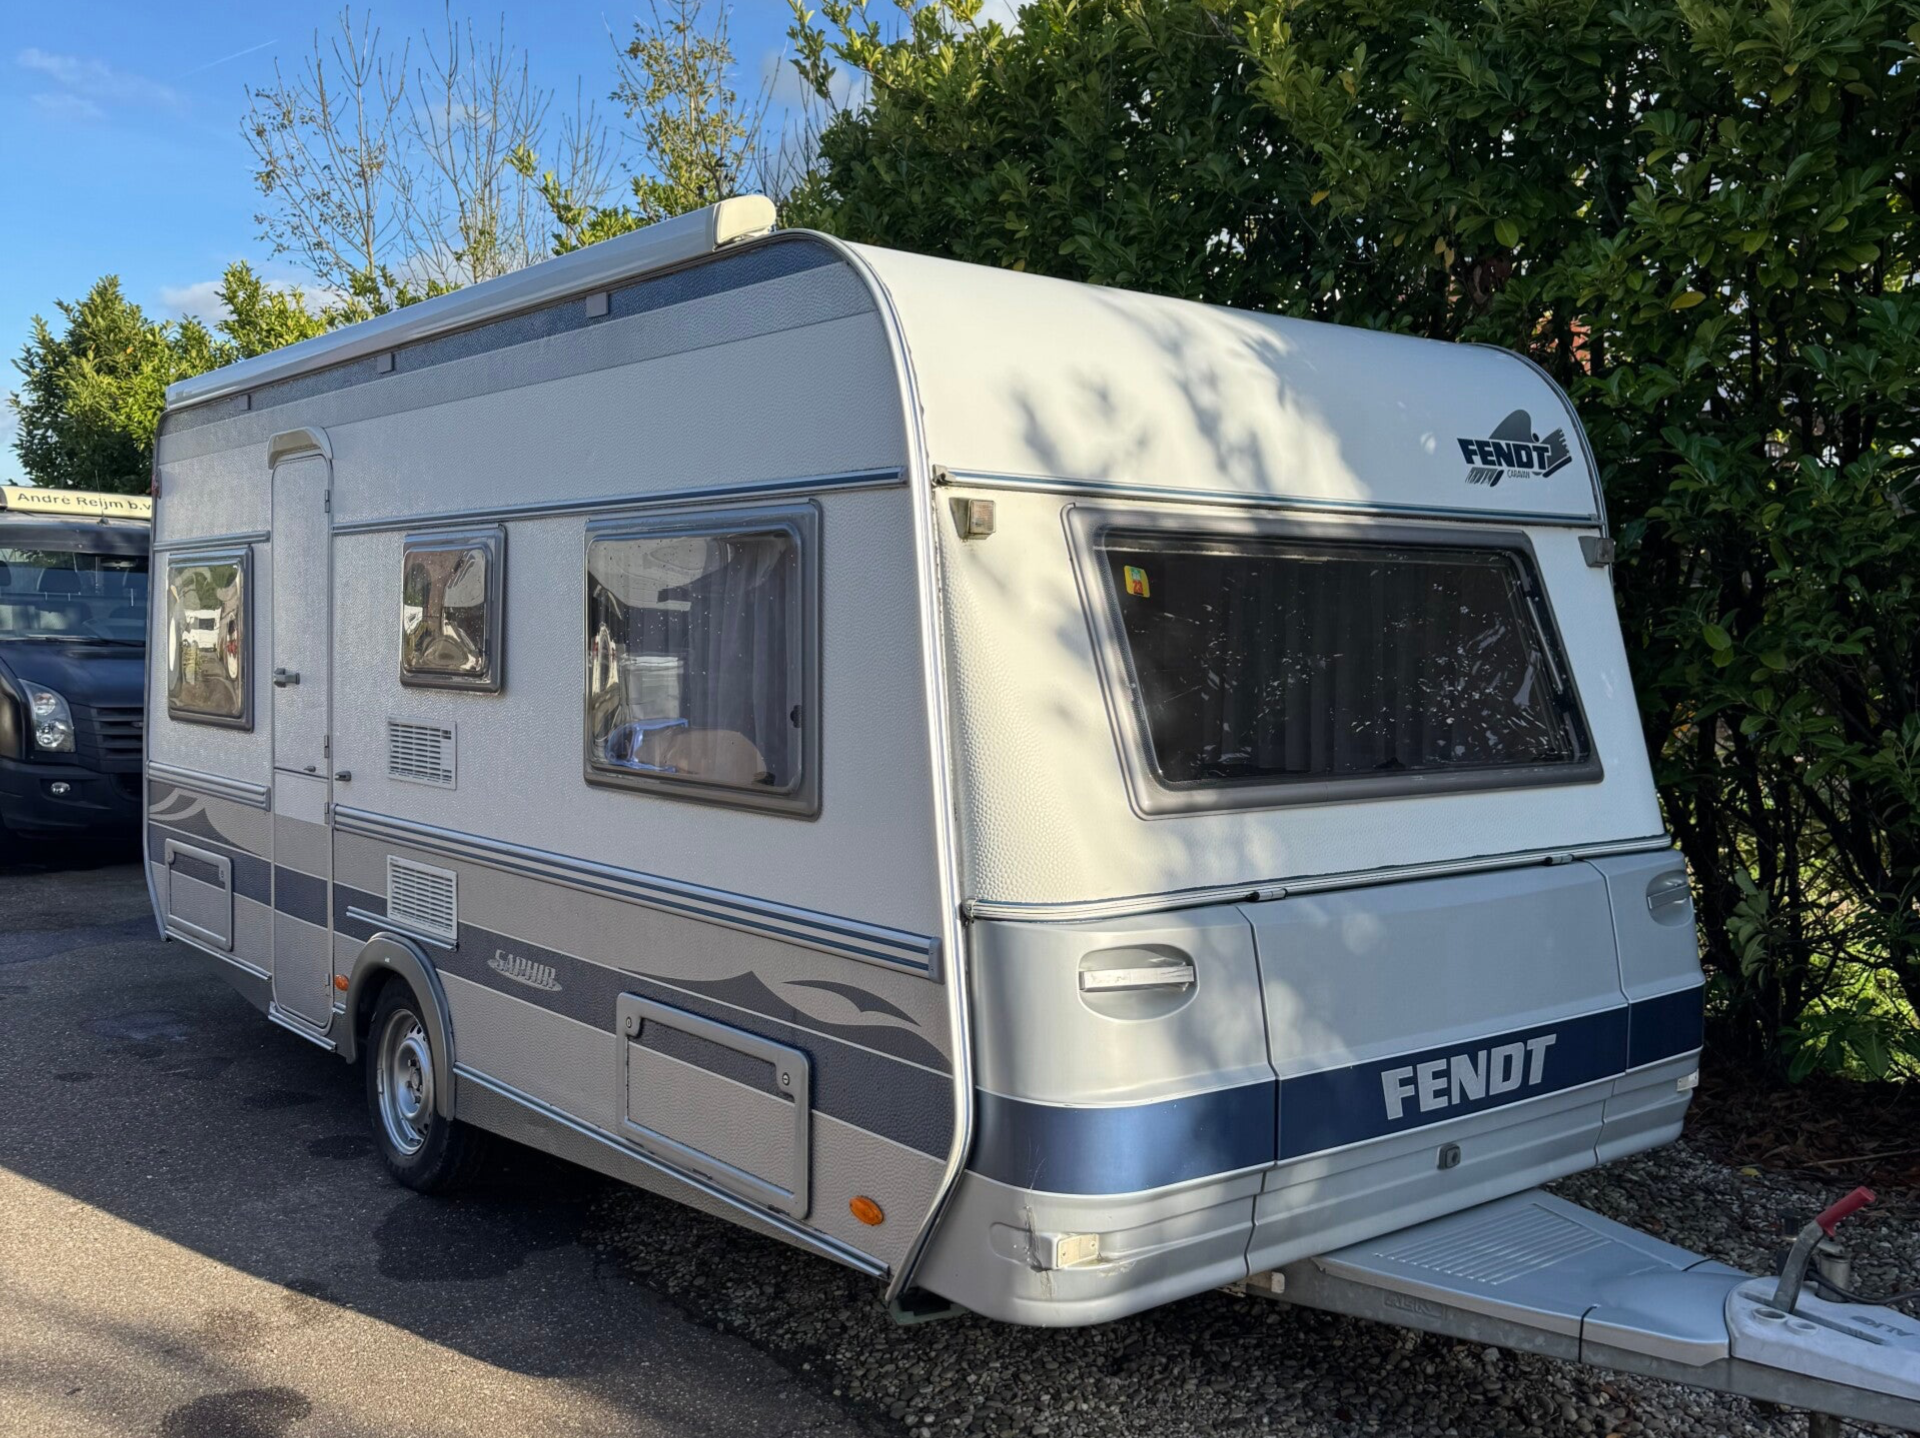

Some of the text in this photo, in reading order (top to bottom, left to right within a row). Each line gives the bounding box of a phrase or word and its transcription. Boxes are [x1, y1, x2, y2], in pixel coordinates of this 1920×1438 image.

[1457, 438, 1550, 470] FENDT
[1507, 469, 1530, 479] CARAVAN
[76, 496, 123, 510] Reijm
[494, 949, 558, 989] SAPHIR
[1381, 1034, 1557, 1120] FENDT
